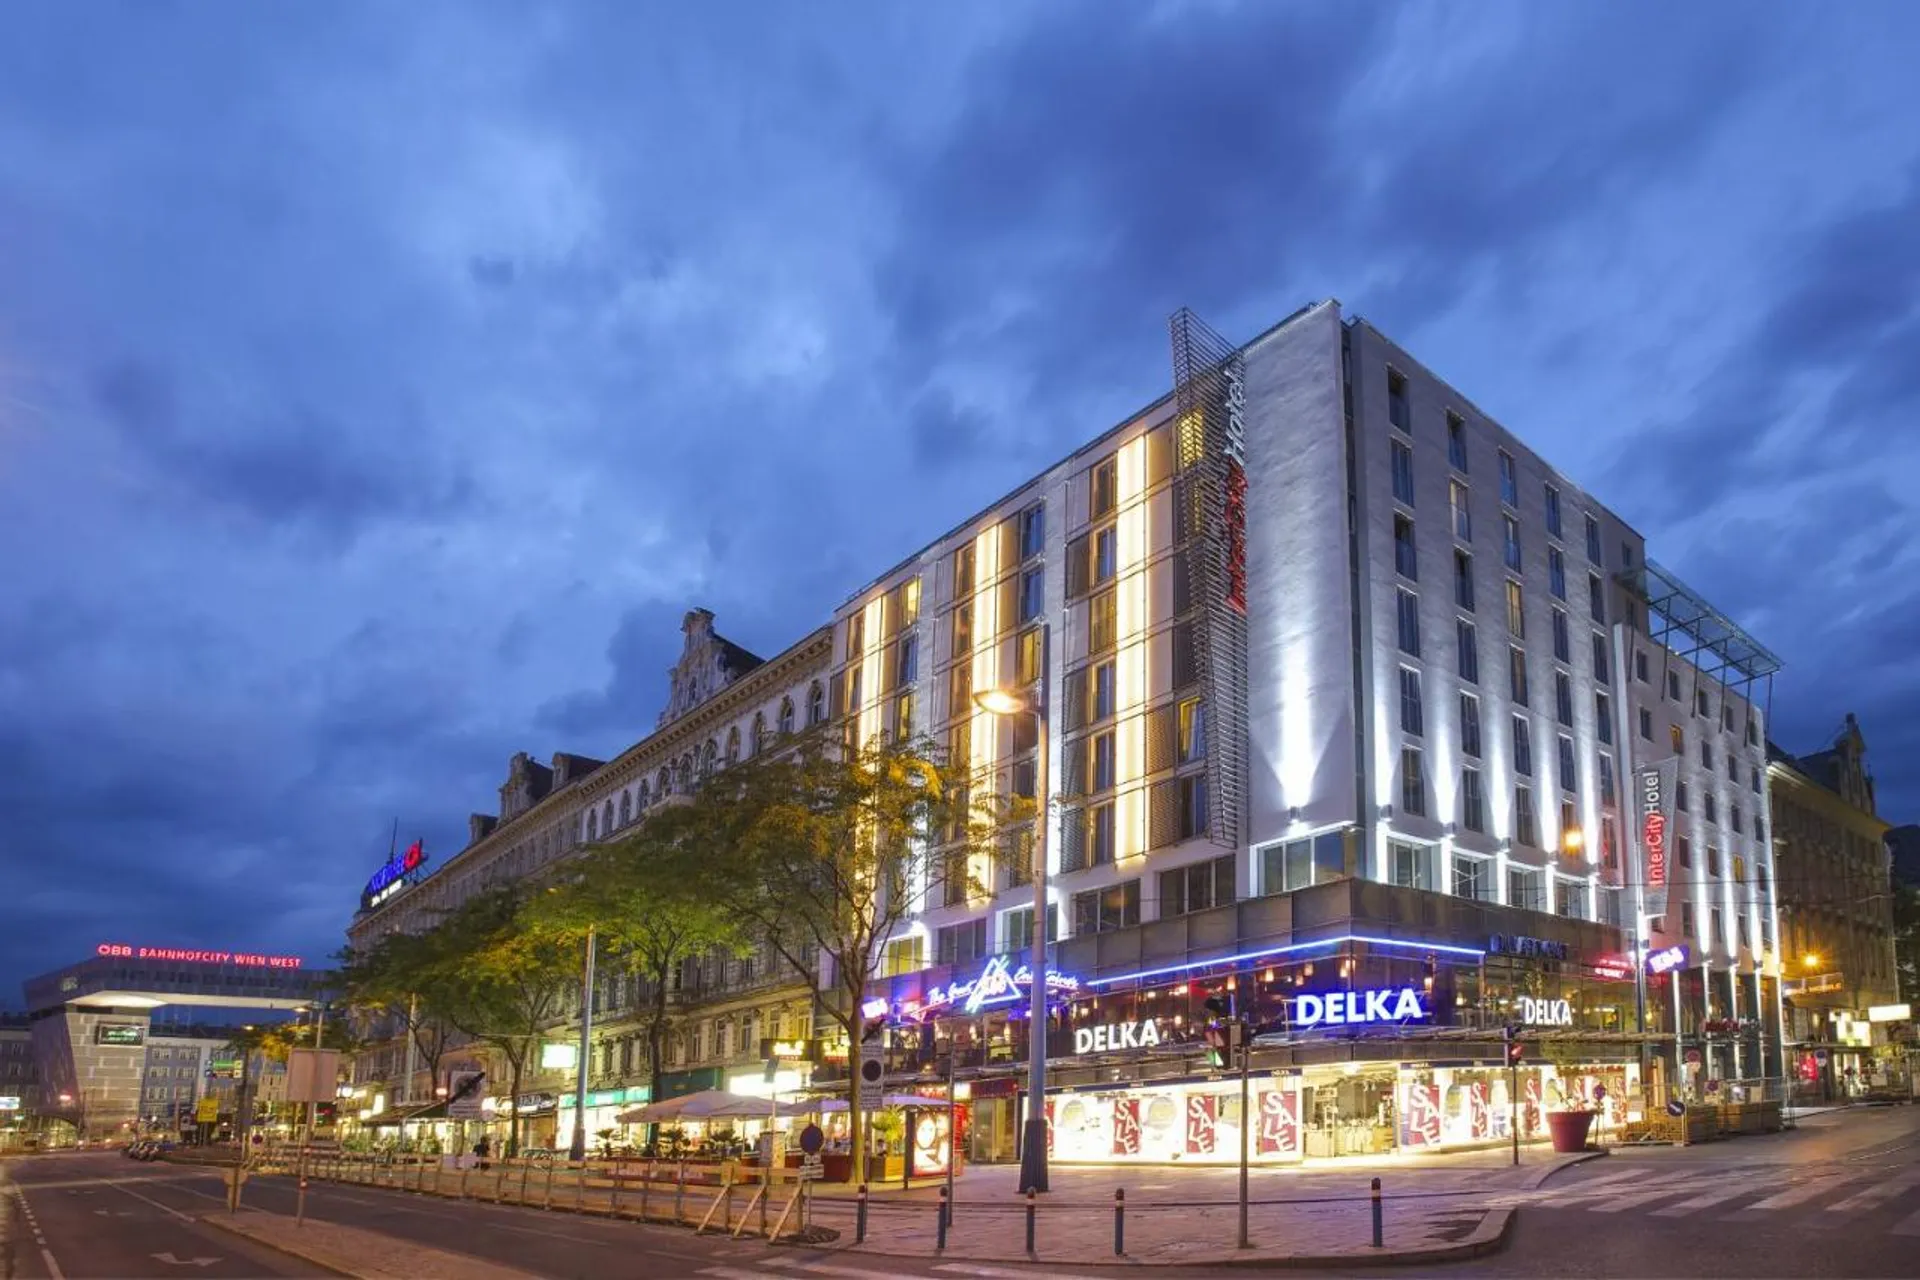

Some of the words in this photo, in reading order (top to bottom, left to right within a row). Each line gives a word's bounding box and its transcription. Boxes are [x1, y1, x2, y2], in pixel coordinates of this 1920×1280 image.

[1643, 771, 1665, 888] InterCityHotel
[139, 947, 230, 962] BAHNHOFCITY
[234, 953, 265, 966] WIEN
[269, 956, 300, 968] WEST
[1296, 988, 1422, 1026] DELKA
[1525, 999, 1572, 1025] DELKA
[1074, 1019, 1160, 1053] DELKA
[1115, 1101, 1139, 1154] SALE
[1188, 1096, 1215, 1153] SALE
[1263, 1092, 1297, 1152] SALE
[1410, 1083, 1441, 1147] SALE
[1471, 1082, 1488, 1139] SALE
